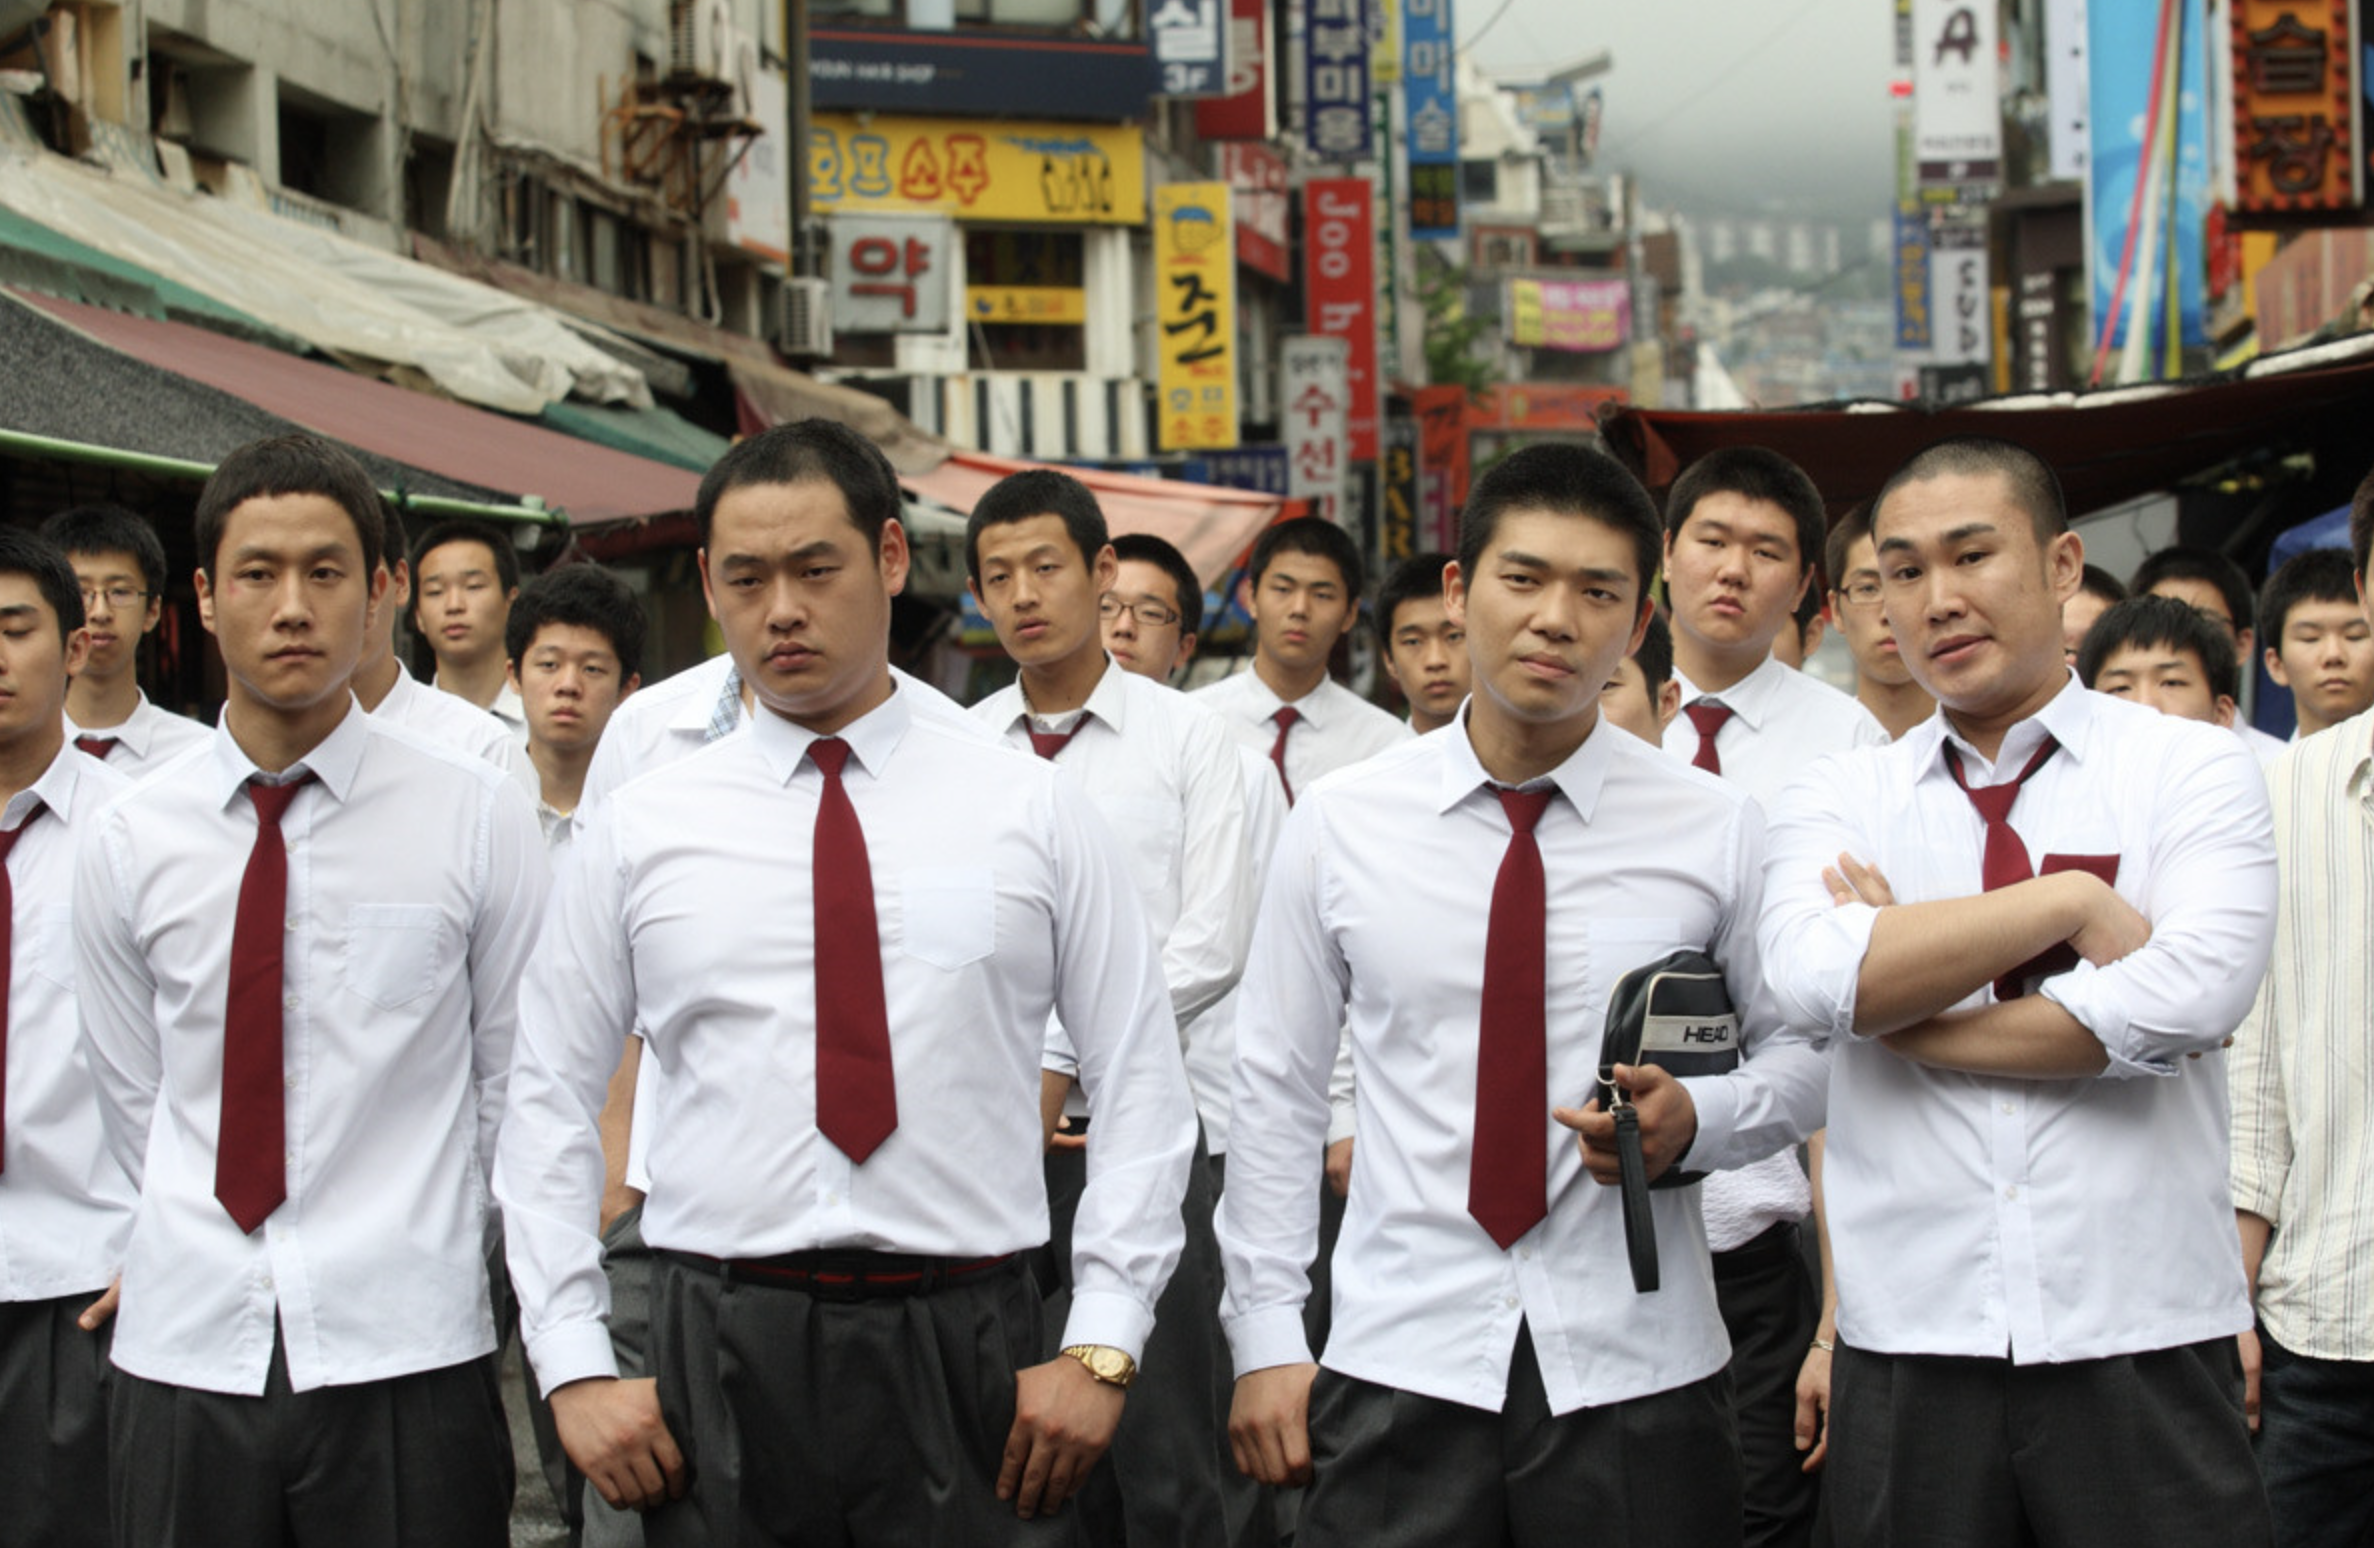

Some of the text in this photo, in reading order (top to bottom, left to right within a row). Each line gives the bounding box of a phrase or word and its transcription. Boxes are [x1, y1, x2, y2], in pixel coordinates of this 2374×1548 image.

[1150, 0, 1218, 61] 실
[1163, 63, 1210, 93] 3F
[899, 134, 990, 207] 소주
[1317, 191, 1362, 280] Joo
[848, 235, 931, 320] 약
[1292, 383, 1338, 522] 수선
[1683, 1025, 1729, 1043] HEAD
